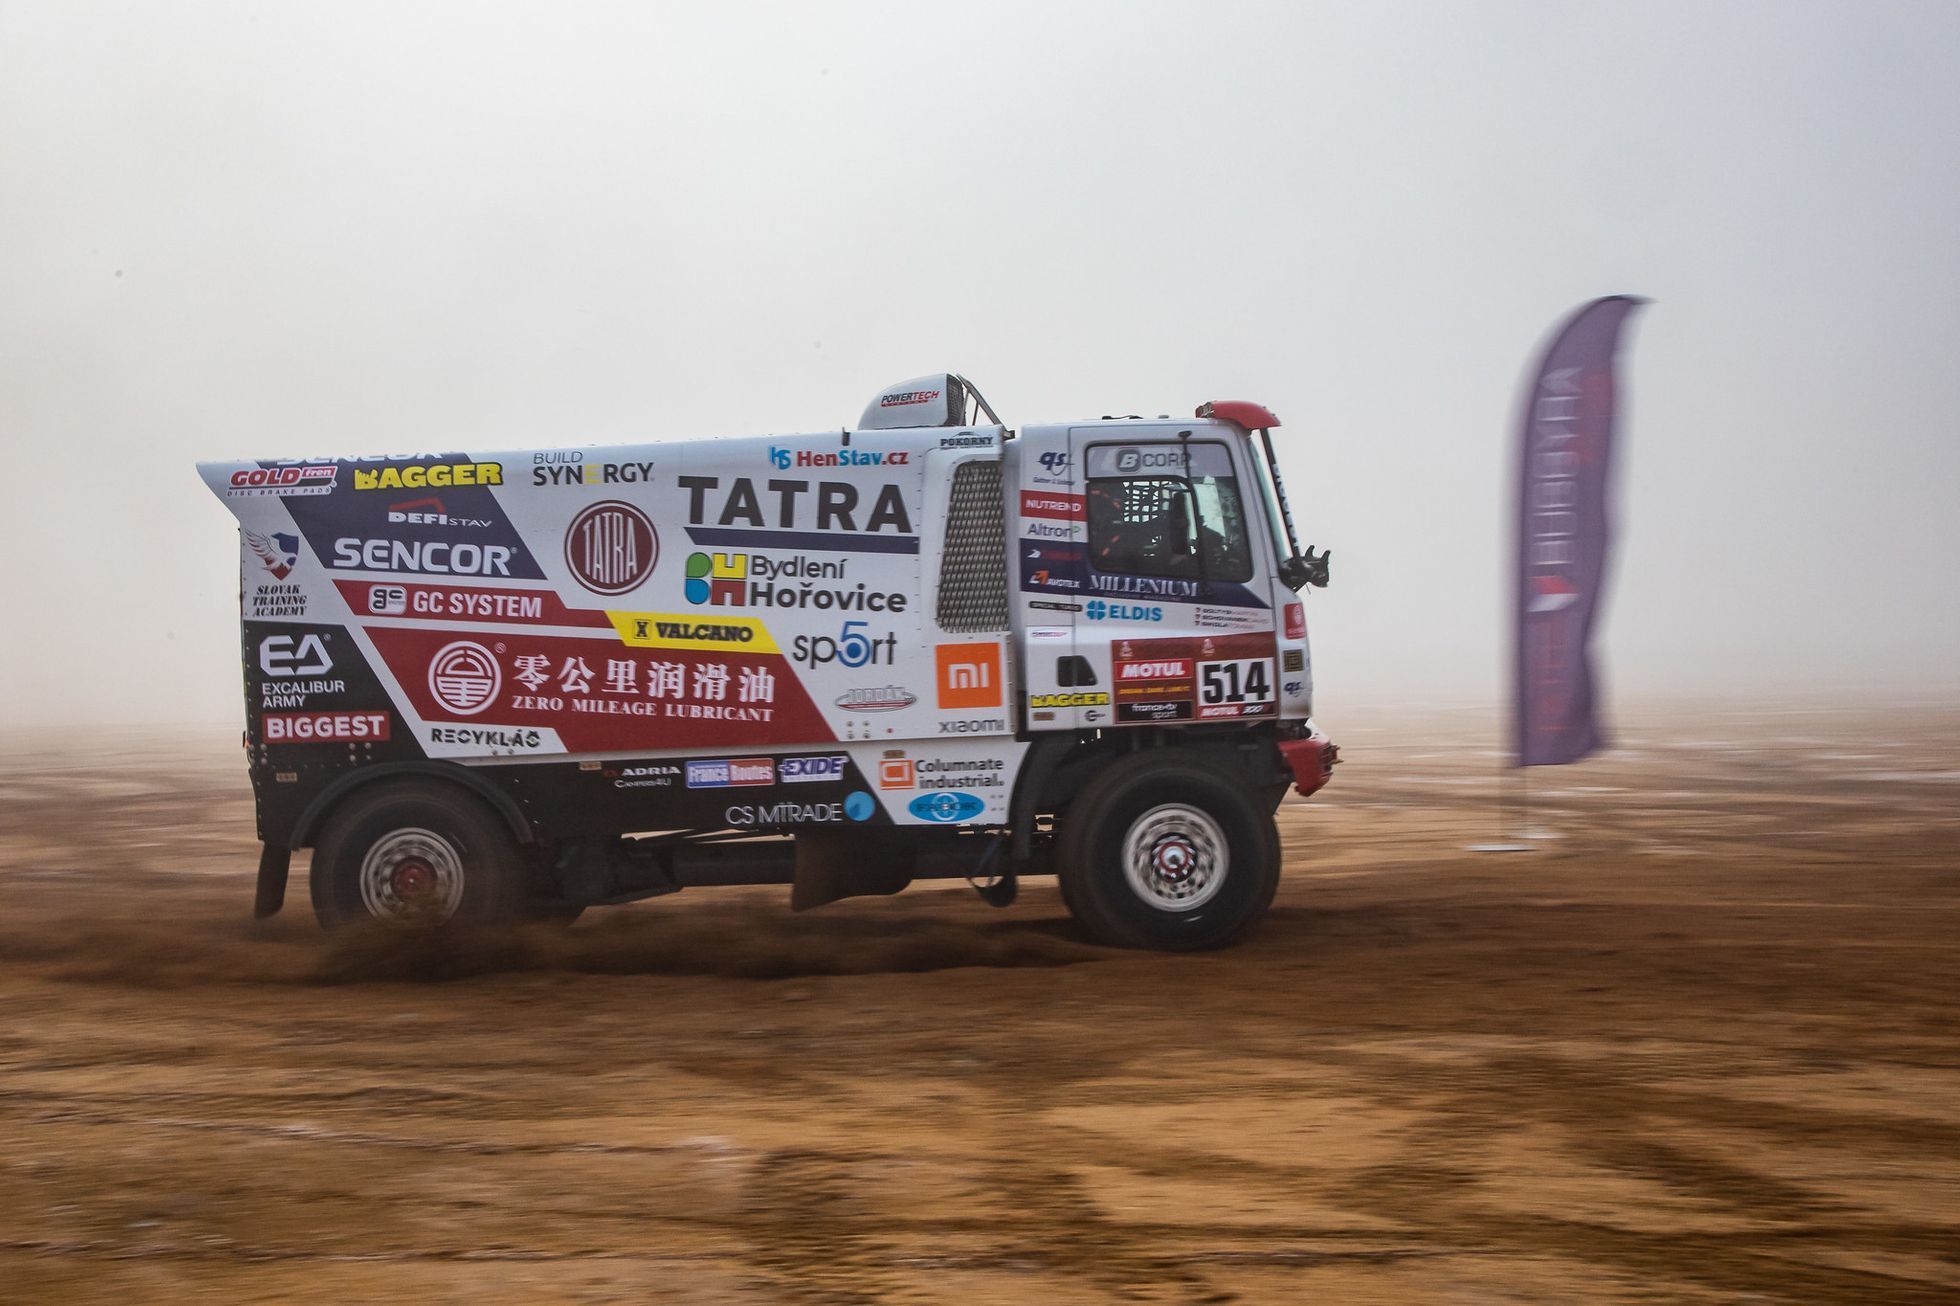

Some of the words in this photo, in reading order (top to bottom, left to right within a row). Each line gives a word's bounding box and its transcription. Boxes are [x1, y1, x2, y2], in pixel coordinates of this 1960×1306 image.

[881, 390, 940, 403] POWERTECH
[533, 451, 584, 464] BUILD
[797, 449, 909, 467] HenStav.cz
[353, 463, 504, 490] BAGGER
[533, 462, 655, 487] SYNERGY
[678, 475, 913, 533] TATRA
[1025, 499, 1082, 512] NUTREND
[333, 537, 511, 576] SENCOR
[583, 511, 639, 585] TATRA
[750, 555, 848, 581] Bydlení
[256, 584, 301, 596] SLOVAK
[1088, 574, 1199, 597] MILLENIUM
[253, 595, 307, 606] TRAINING
[413, 590, 444, 614] GC
[449, 592, 542, 618] SYSTEM
[750, 582, 908, 613] Hořovice
[253, 606, 307, 617] ACADEMY
[1109, 605, 1163, 622] ELDIS
[656, 621, 754, 643] VALCANO
[513, 654, 776, 703] 零公里润滑油
[1121, 662, 1186, 678] MOTUL
[262, 680, 345, 695] EXCALIBUR
[1203, 661, 1270, 704] 514
[262, 695, 306, 710] ARMY
[512, 695, 563, 712] ZERO
[571, 697, 656, 717] MILEAGE
[664, 703, 774, 723] LUBRICANT
[266, 715, 385, 739] BIGGEST
[938, 719, 1005, 733] xiaomi
[622, 765, 681, 777] ADRIA
[781, 757, 845, 775] EXIDE
[725, 805, 755, 825] CS
